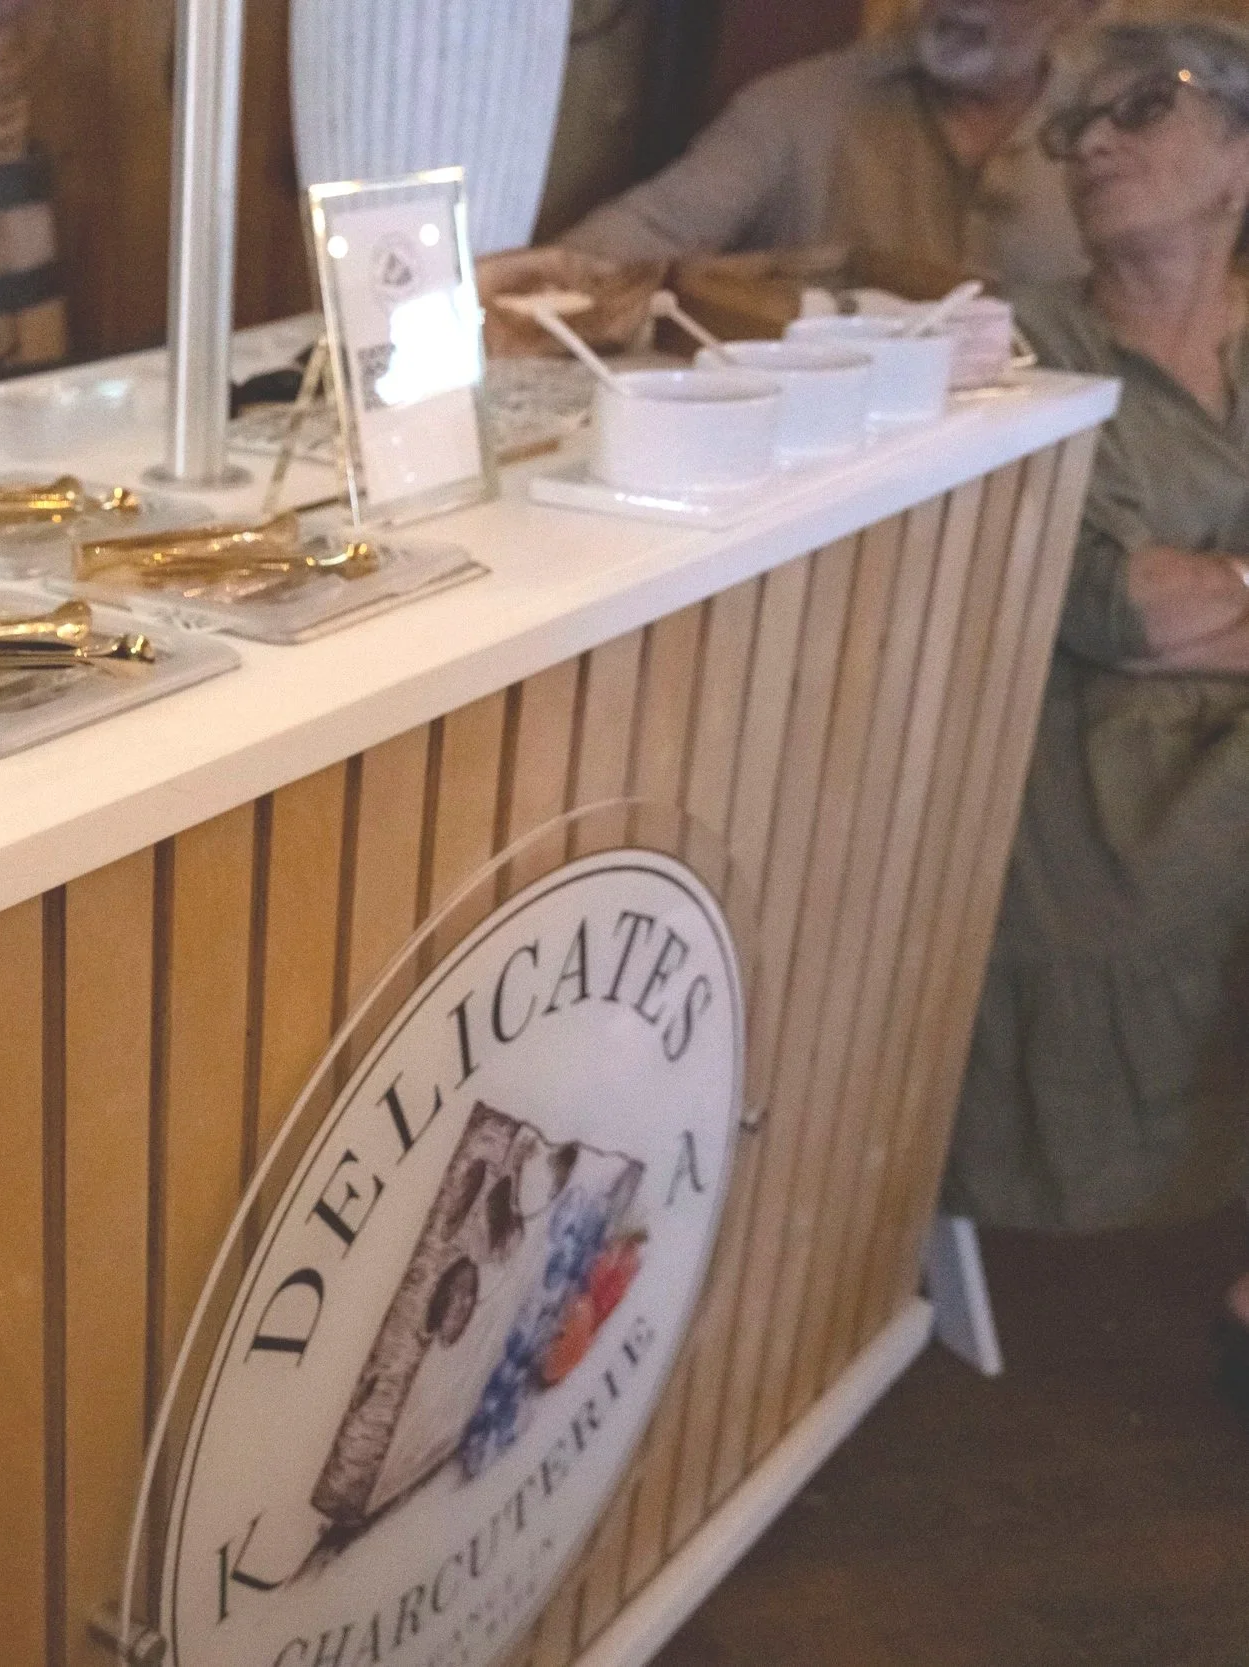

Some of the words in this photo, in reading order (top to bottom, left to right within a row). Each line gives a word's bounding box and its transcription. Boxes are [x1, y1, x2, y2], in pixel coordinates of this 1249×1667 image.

[244, 908, 712, 1367] DELICATES
[664, 1129, 707, 1208] A
[216, 1512, 290, 1625] K
[275, 1316, 656, 1667] CHARCUTERIE
